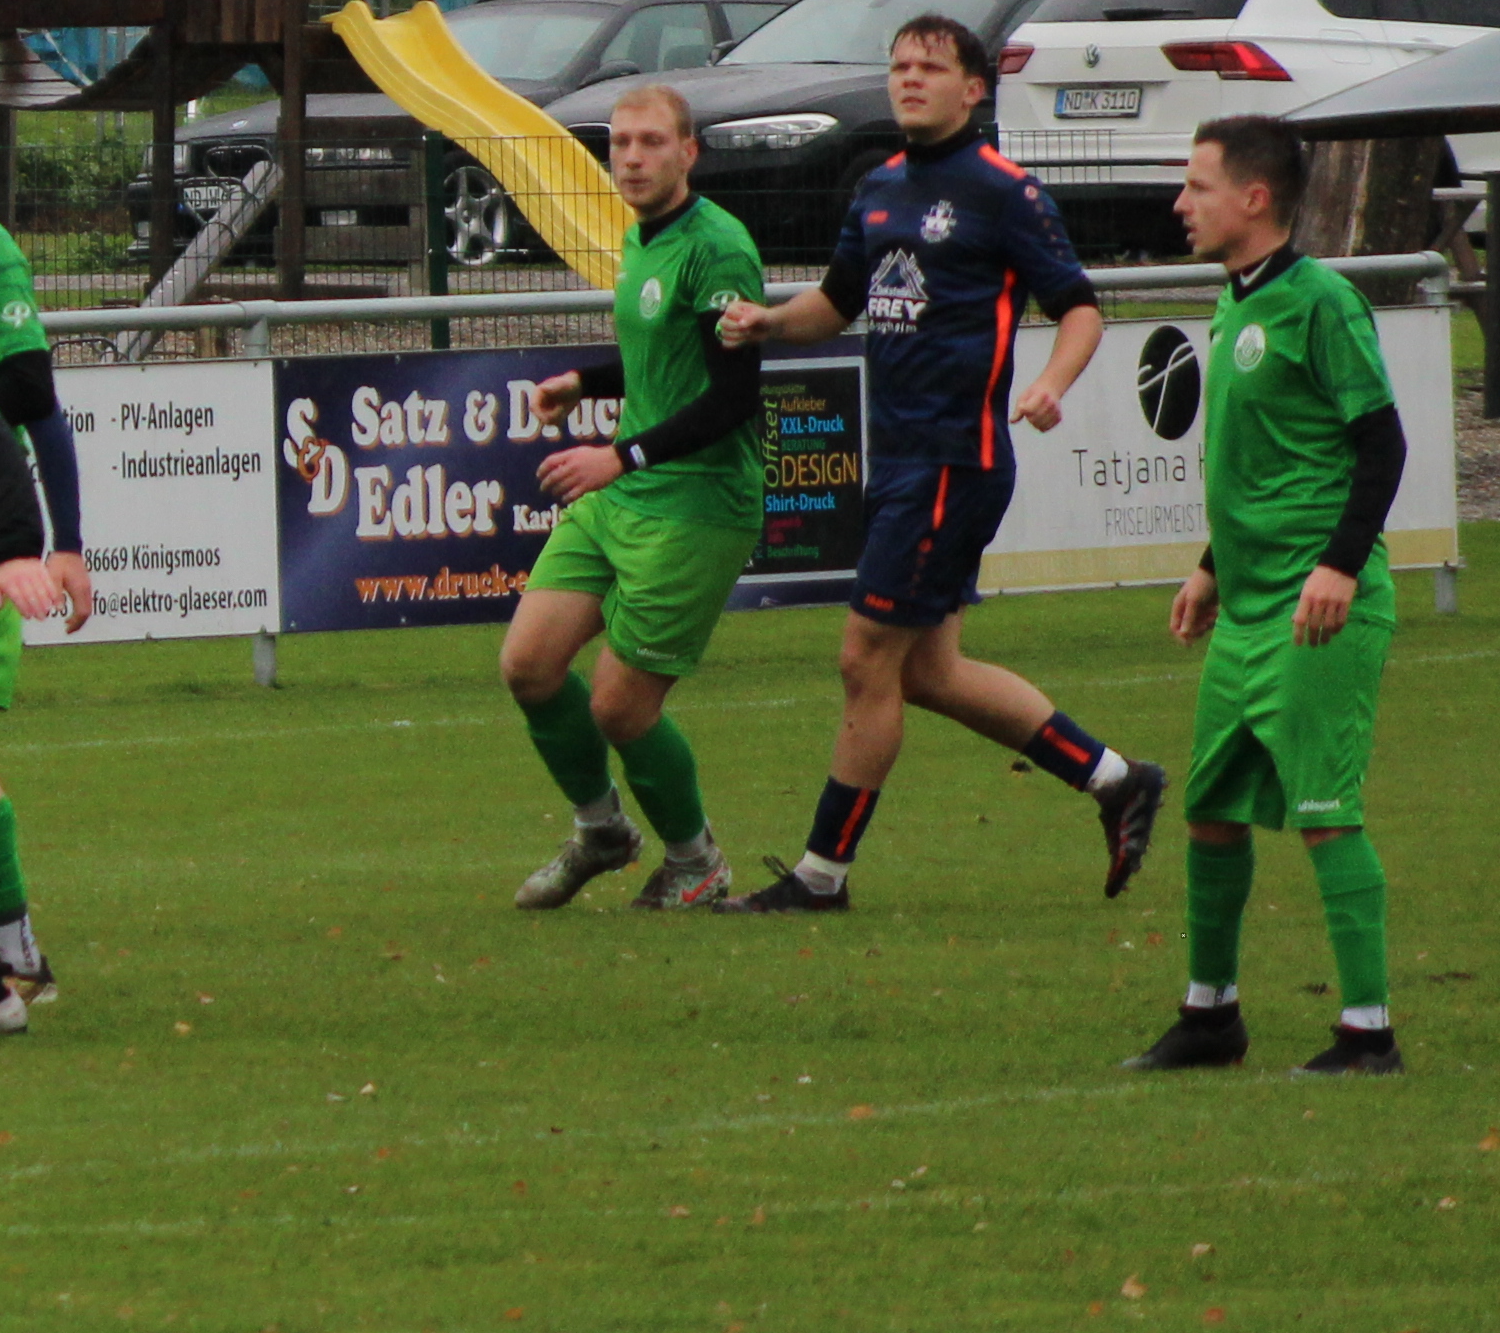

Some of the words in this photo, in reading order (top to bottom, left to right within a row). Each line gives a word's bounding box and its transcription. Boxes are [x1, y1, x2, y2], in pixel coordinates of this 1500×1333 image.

[1064, 92, 1082, 110] ND
[868, 297, 926, 321] FREY
[121, 402, 214, 436] PV-Anlagen
[352, 386, 449, 447] Satz
[463, 390, 497, 443] &
[506, 380, 622, 440] Duc
[781, 397, 826, 413] Aufkleber
[781, 414, 845, 434] XXL-Druck
[762, 398, 780, 488] Offset
[781, 438, 827, 451] BERATUNG
[122, 446, 261, 481] Industrieanlagen
[781, 452, 858, 487] DESIGN
[1072, 448, 1186, 495] Tatjana
[354, 464, 503, 540] Edler
[513, 503, 558, 533] Karl
[765, 492, 835, 513] Shirt-Druck
[1105, 503, 1210, 536] FRISEURMEIST
[85, 548, 128, 573] 86669
[132, 544, 221, 575] Königsmoos
[355, 564, 528, 603] www.druck-e
